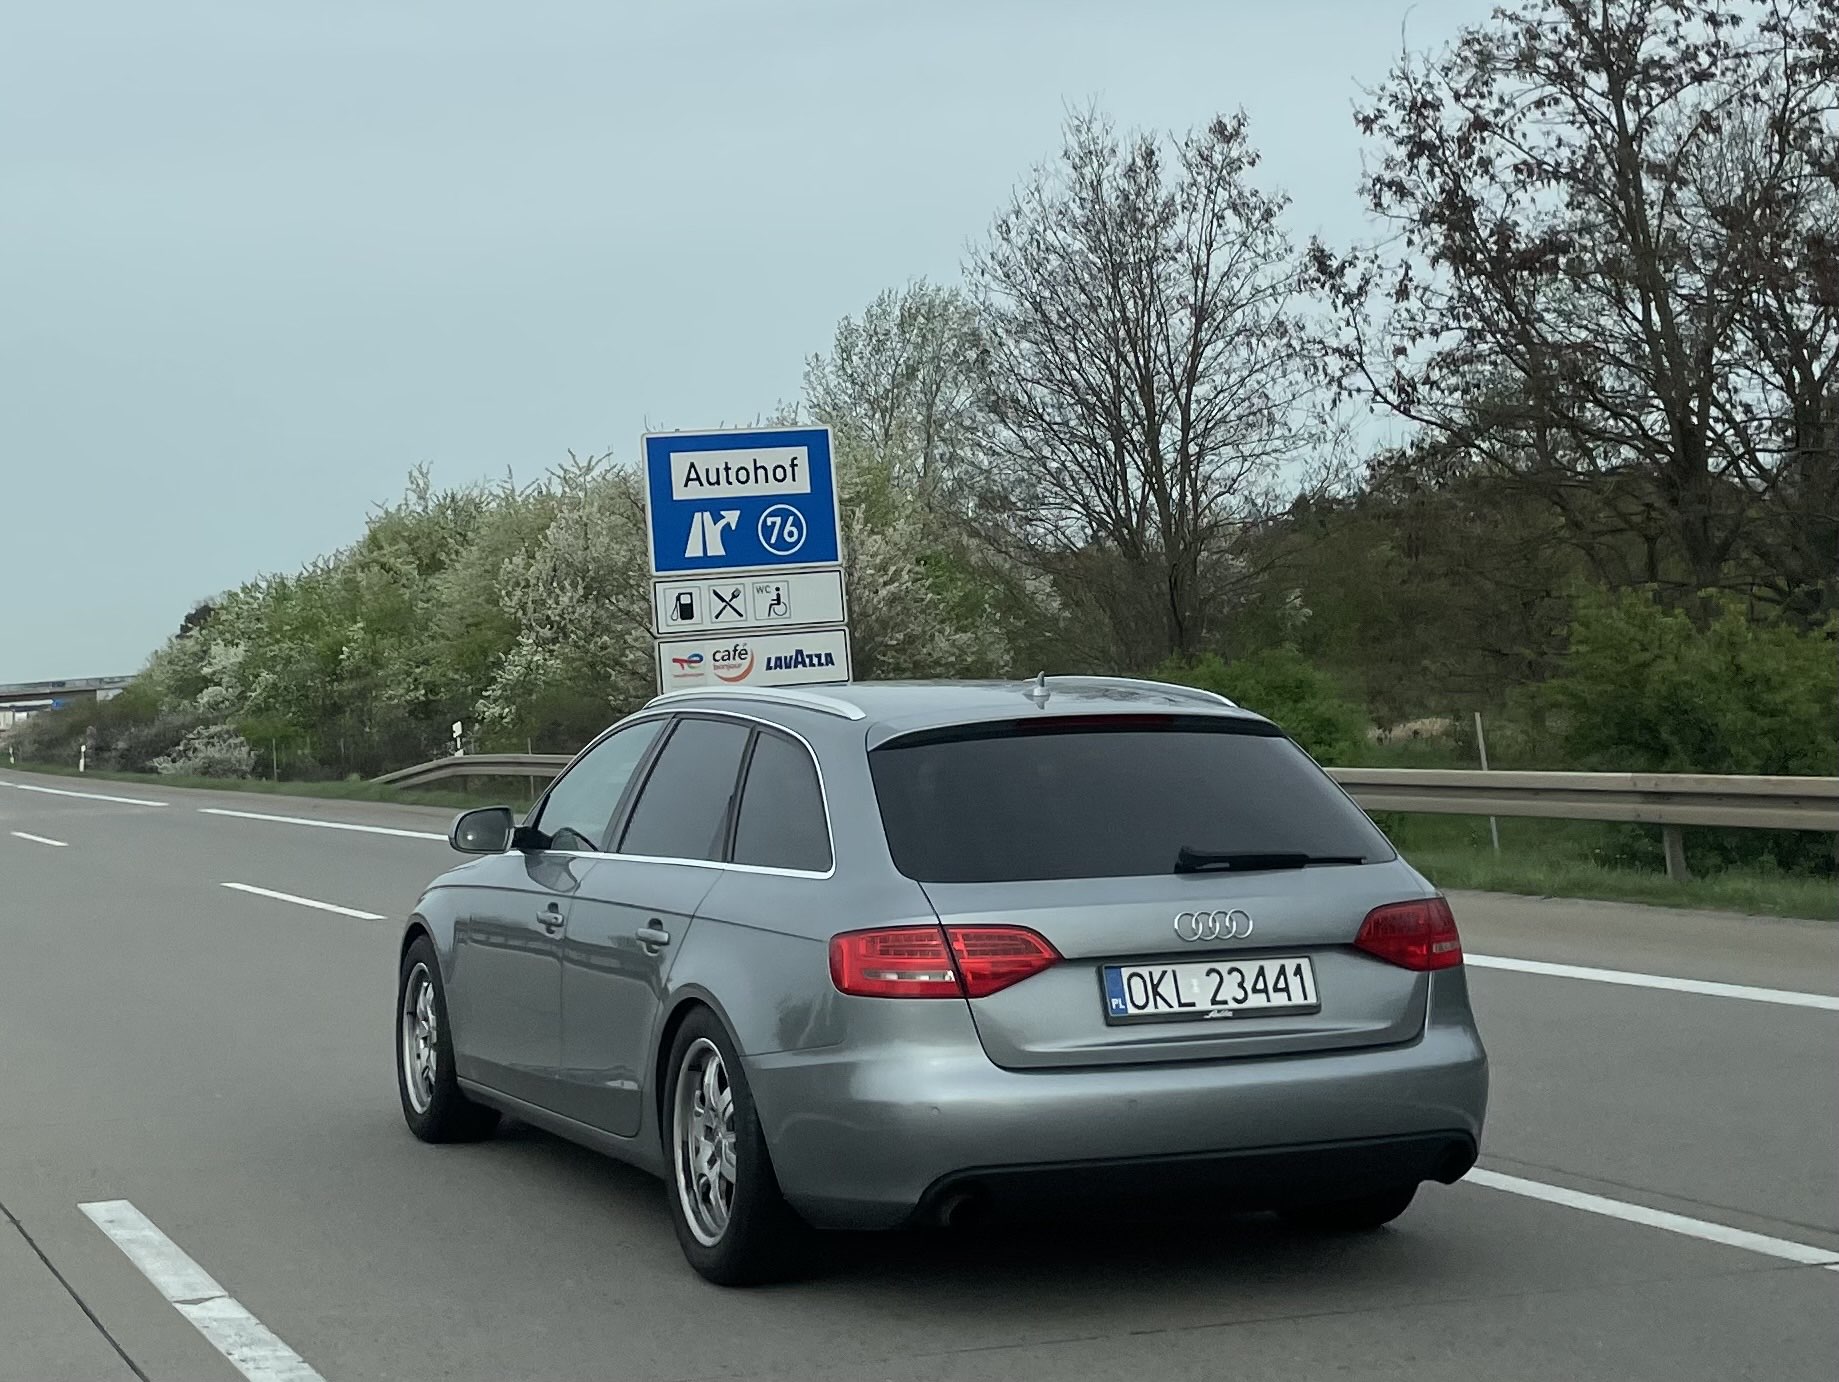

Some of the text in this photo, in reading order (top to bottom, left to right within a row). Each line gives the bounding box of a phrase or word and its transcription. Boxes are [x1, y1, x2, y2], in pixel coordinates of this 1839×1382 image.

[683, 457, 799, 488] Autohof
[766, 515, 799, 544] 76
[755, 584, 771, 594] WC
[712, 642, 749, 662] café
[765, 649, 836, 671] LAVAZZA
[1126, 963, 1308, 1011] OKL 23441
[1111, 998, 1126, 1010] PL
